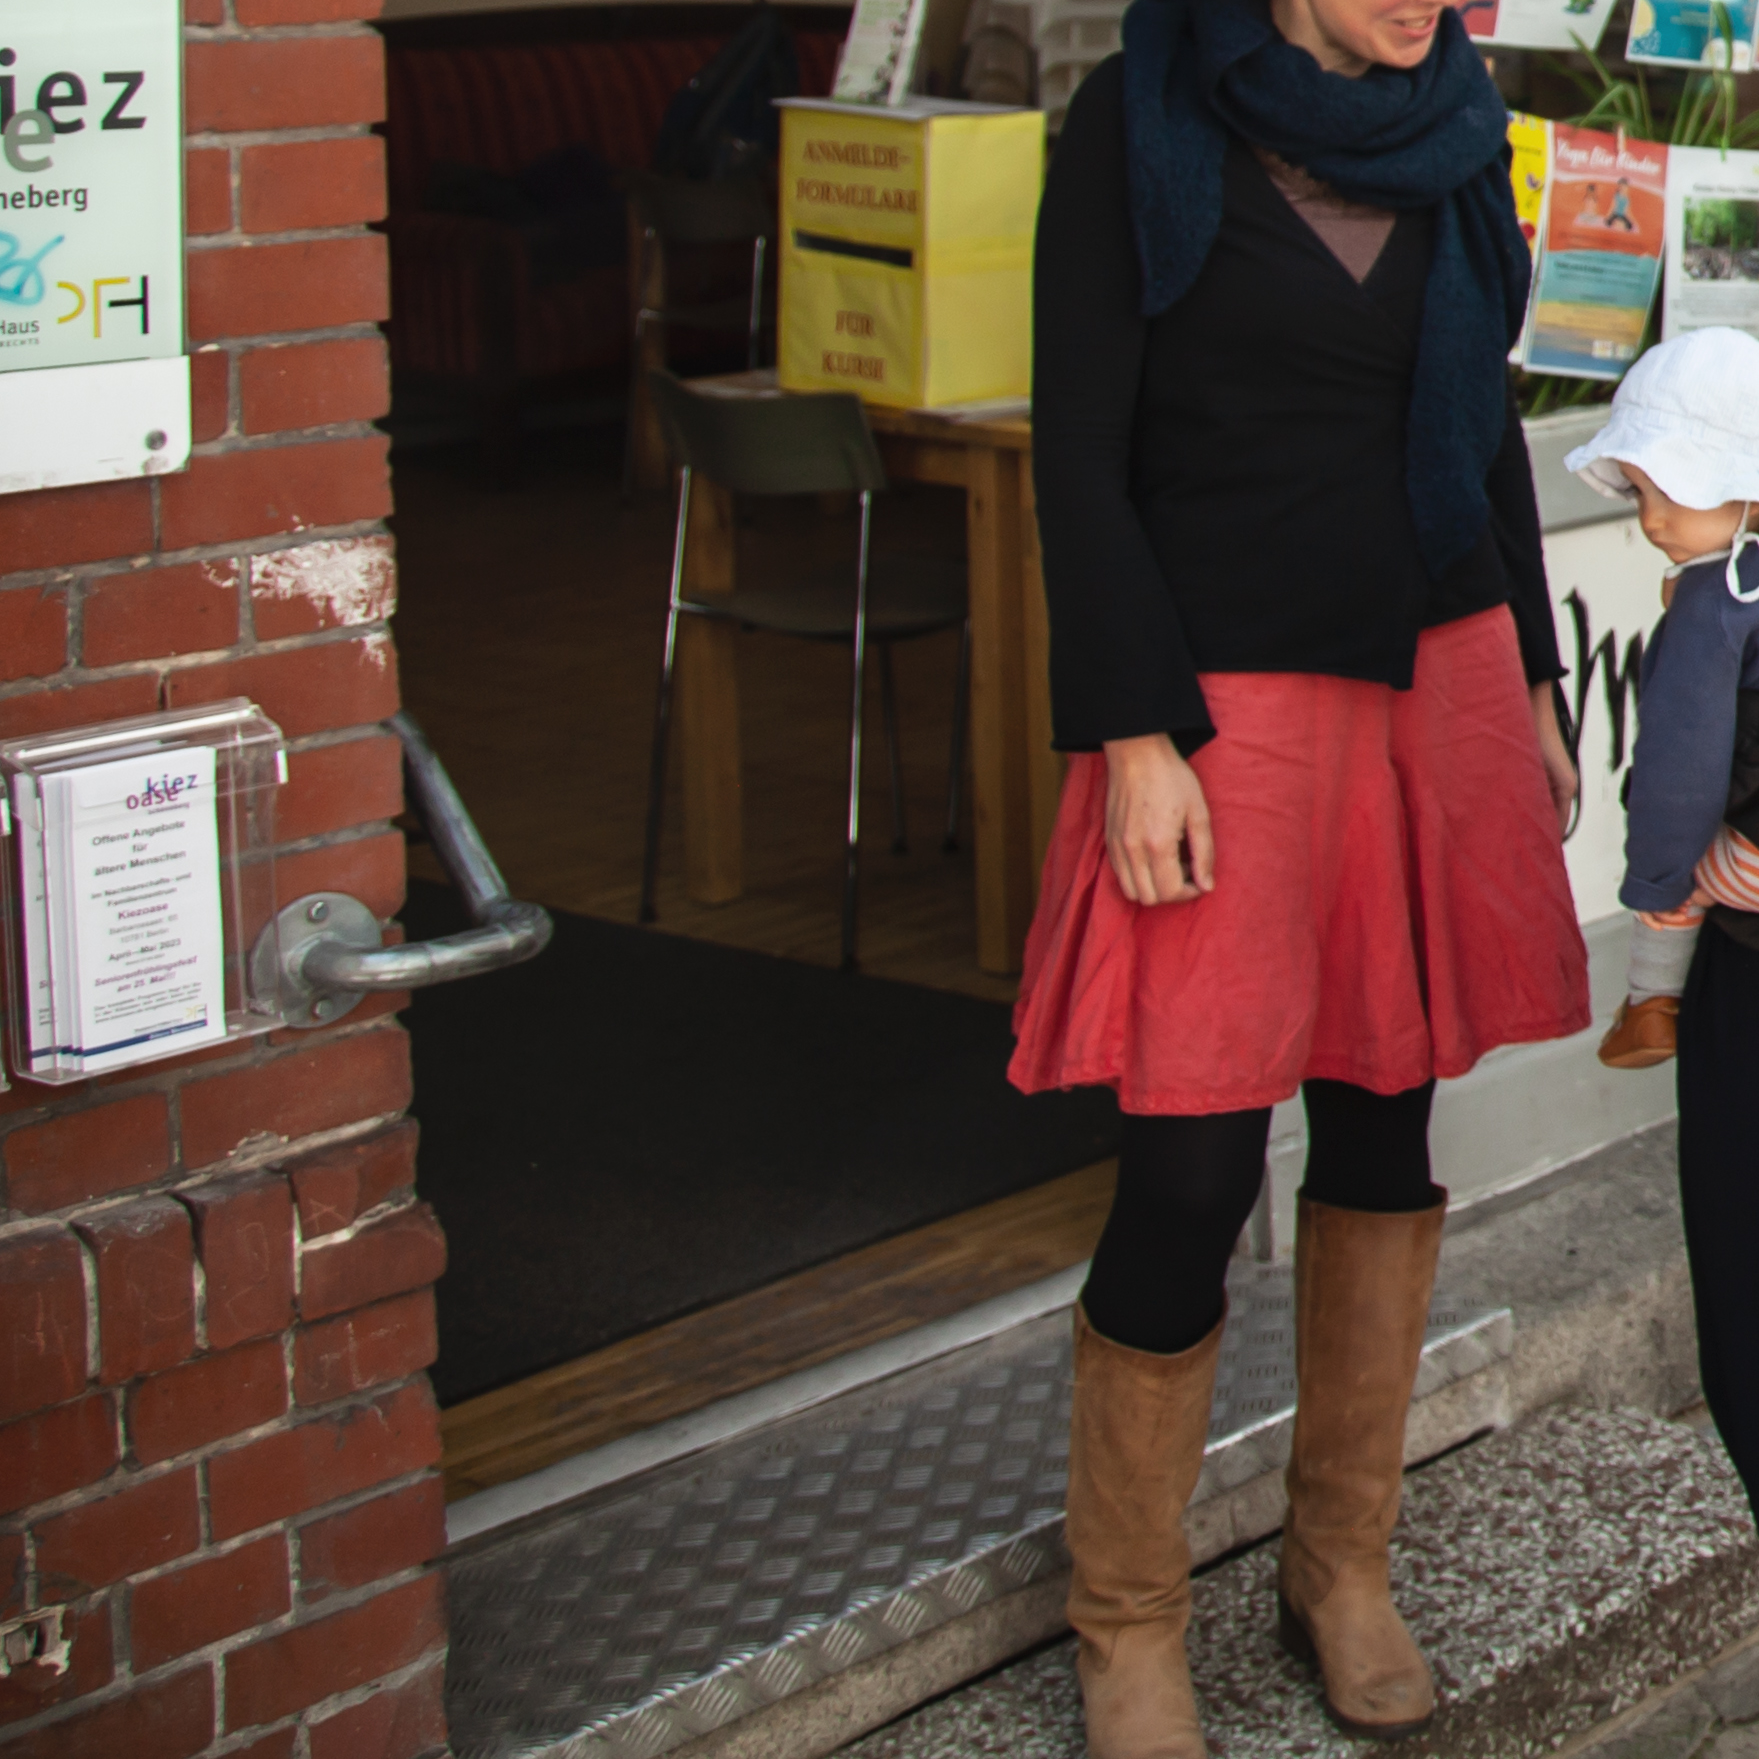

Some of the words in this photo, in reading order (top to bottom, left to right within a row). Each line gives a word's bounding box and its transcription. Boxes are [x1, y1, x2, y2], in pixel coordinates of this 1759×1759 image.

[0, 47, 147, 135] iez
[1557, 137, 1587, 169] Yoga
[0, 183, 88, 212] neberg
[146, 773, 198, 795] kiez
[118, 902, 169, 920] Kiezoase
